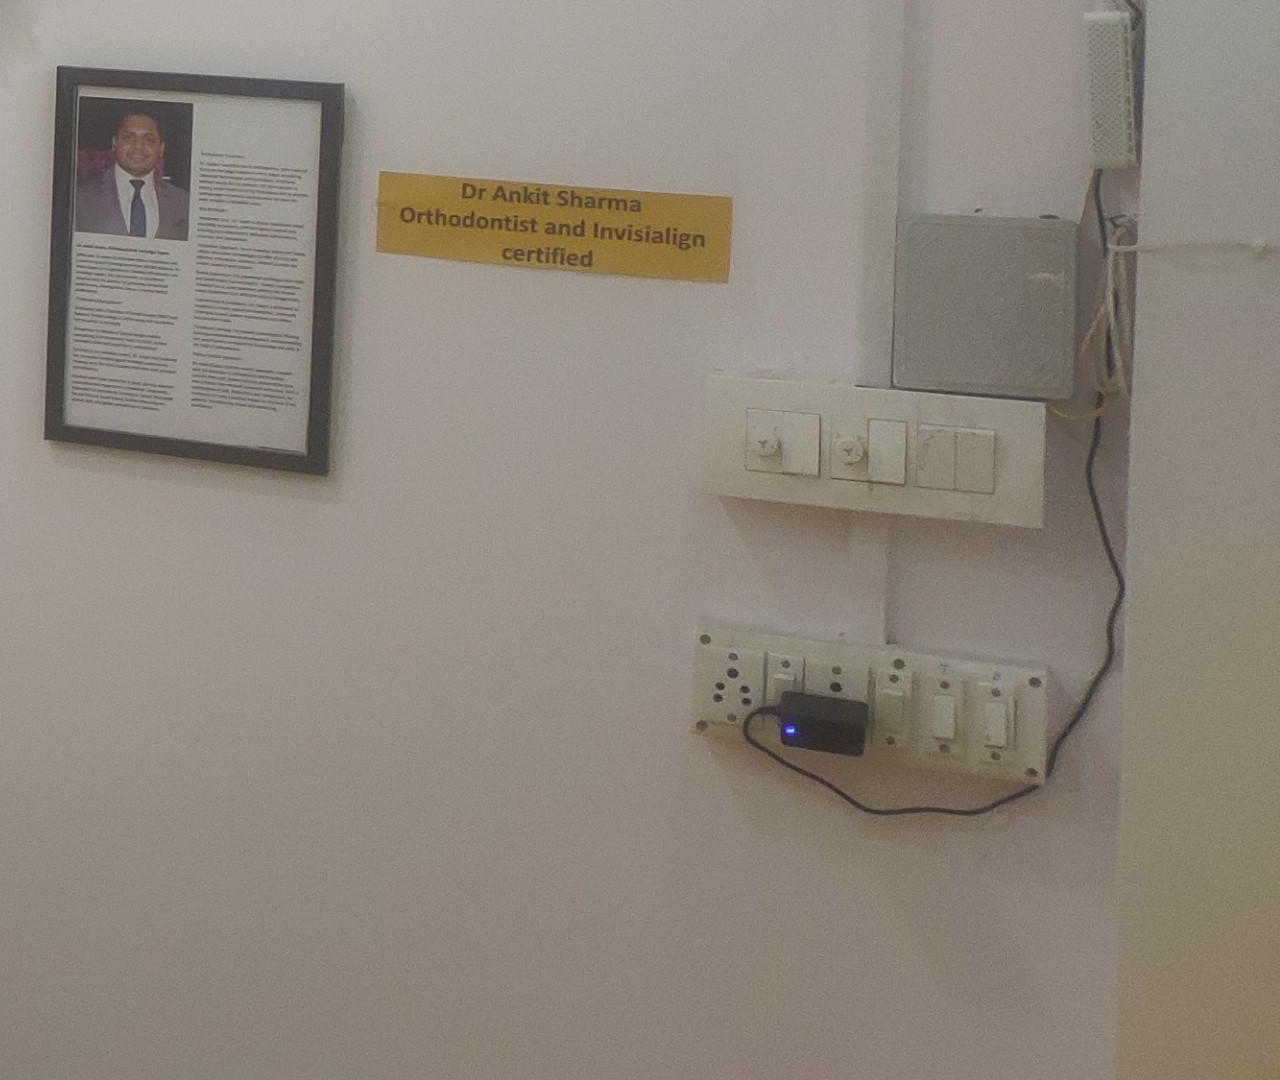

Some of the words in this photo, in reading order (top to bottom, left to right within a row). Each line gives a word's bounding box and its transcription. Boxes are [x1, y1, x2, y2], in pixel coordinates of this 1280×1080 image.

[461, 183, 486, 201] Dr
[492, 184, 550, 206] Ankit
[557, 190, 642, 213] Sharma
[400, 206, 538, 234] Orthodontist
[544, 219, 586, 237] and
[593, 222, 706, 249] Invisialign
[501, 244, 593, 268] certified
